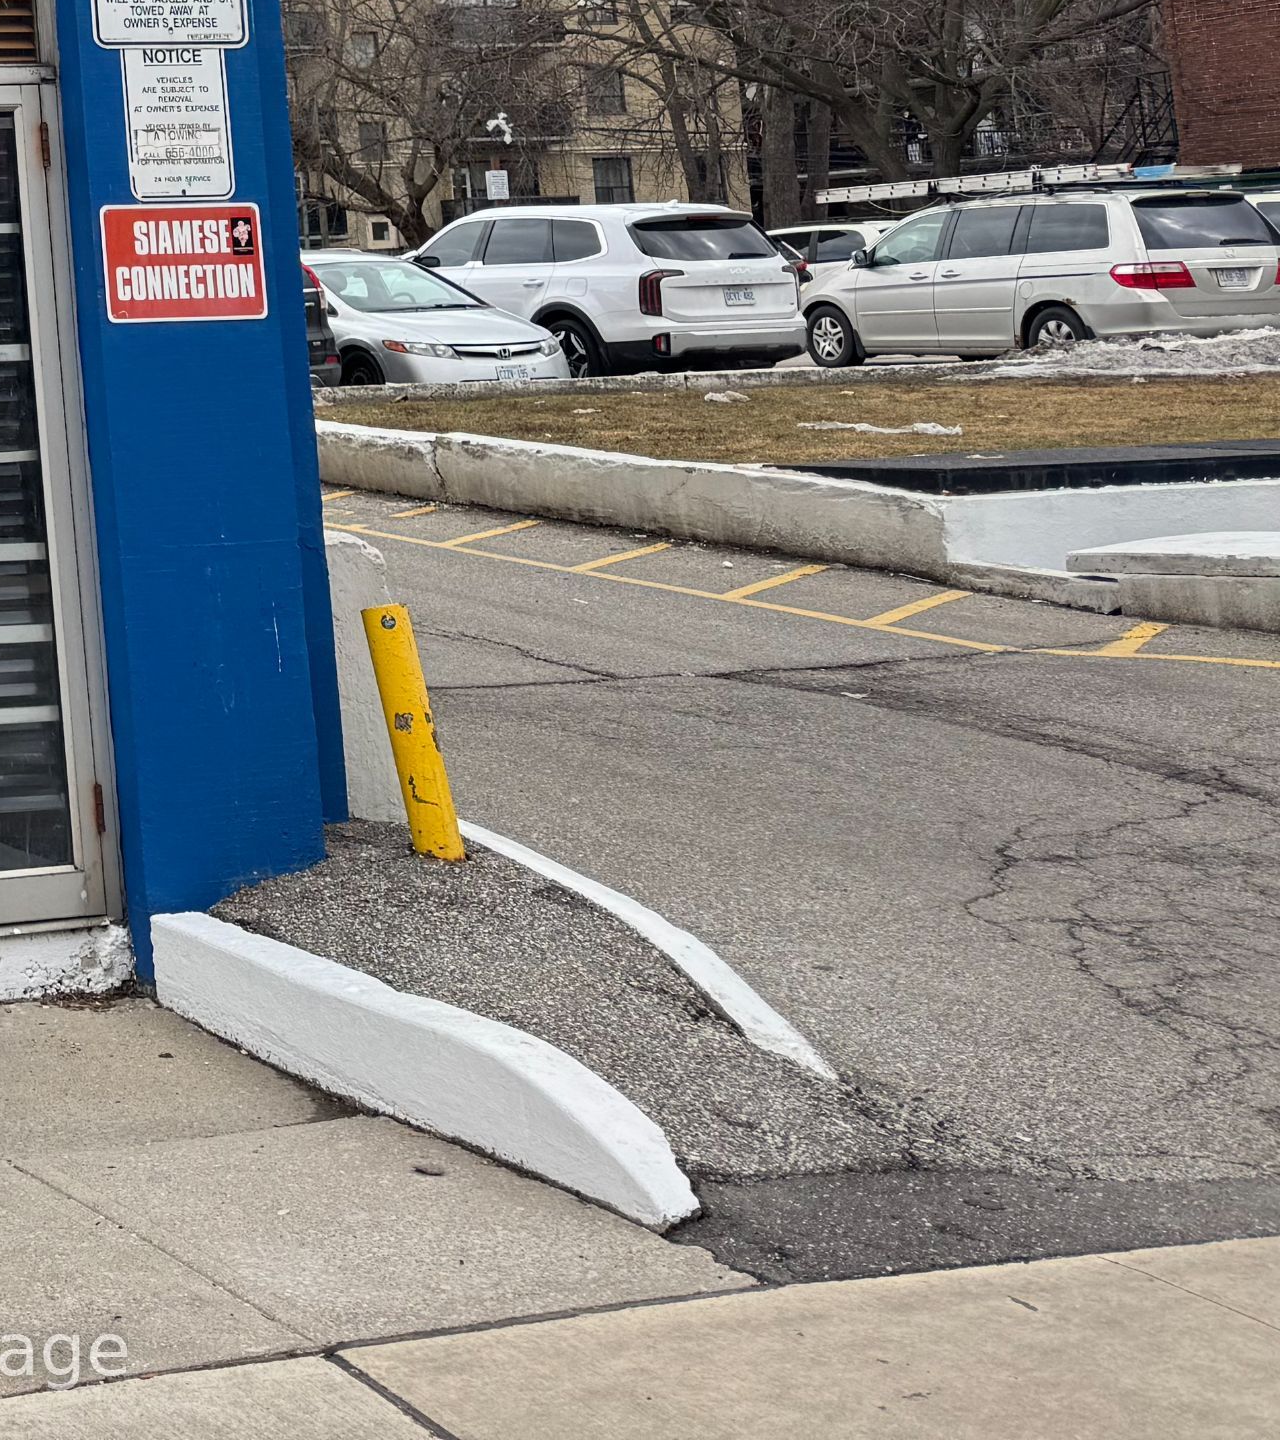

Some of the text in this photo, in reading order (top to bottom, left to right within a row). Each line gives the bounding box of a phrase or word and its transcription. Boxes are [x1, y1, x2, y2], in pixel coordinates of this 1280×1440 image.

[130, 6, 209, 16] TOWED AWAY AT
[173, 18, 218, 28] EXPENSE
[143, 49, 202, 63] NOTICE
[133, 219, 230, 255] SIAMESE
[116, 263, 255, 301] CONNECTION
